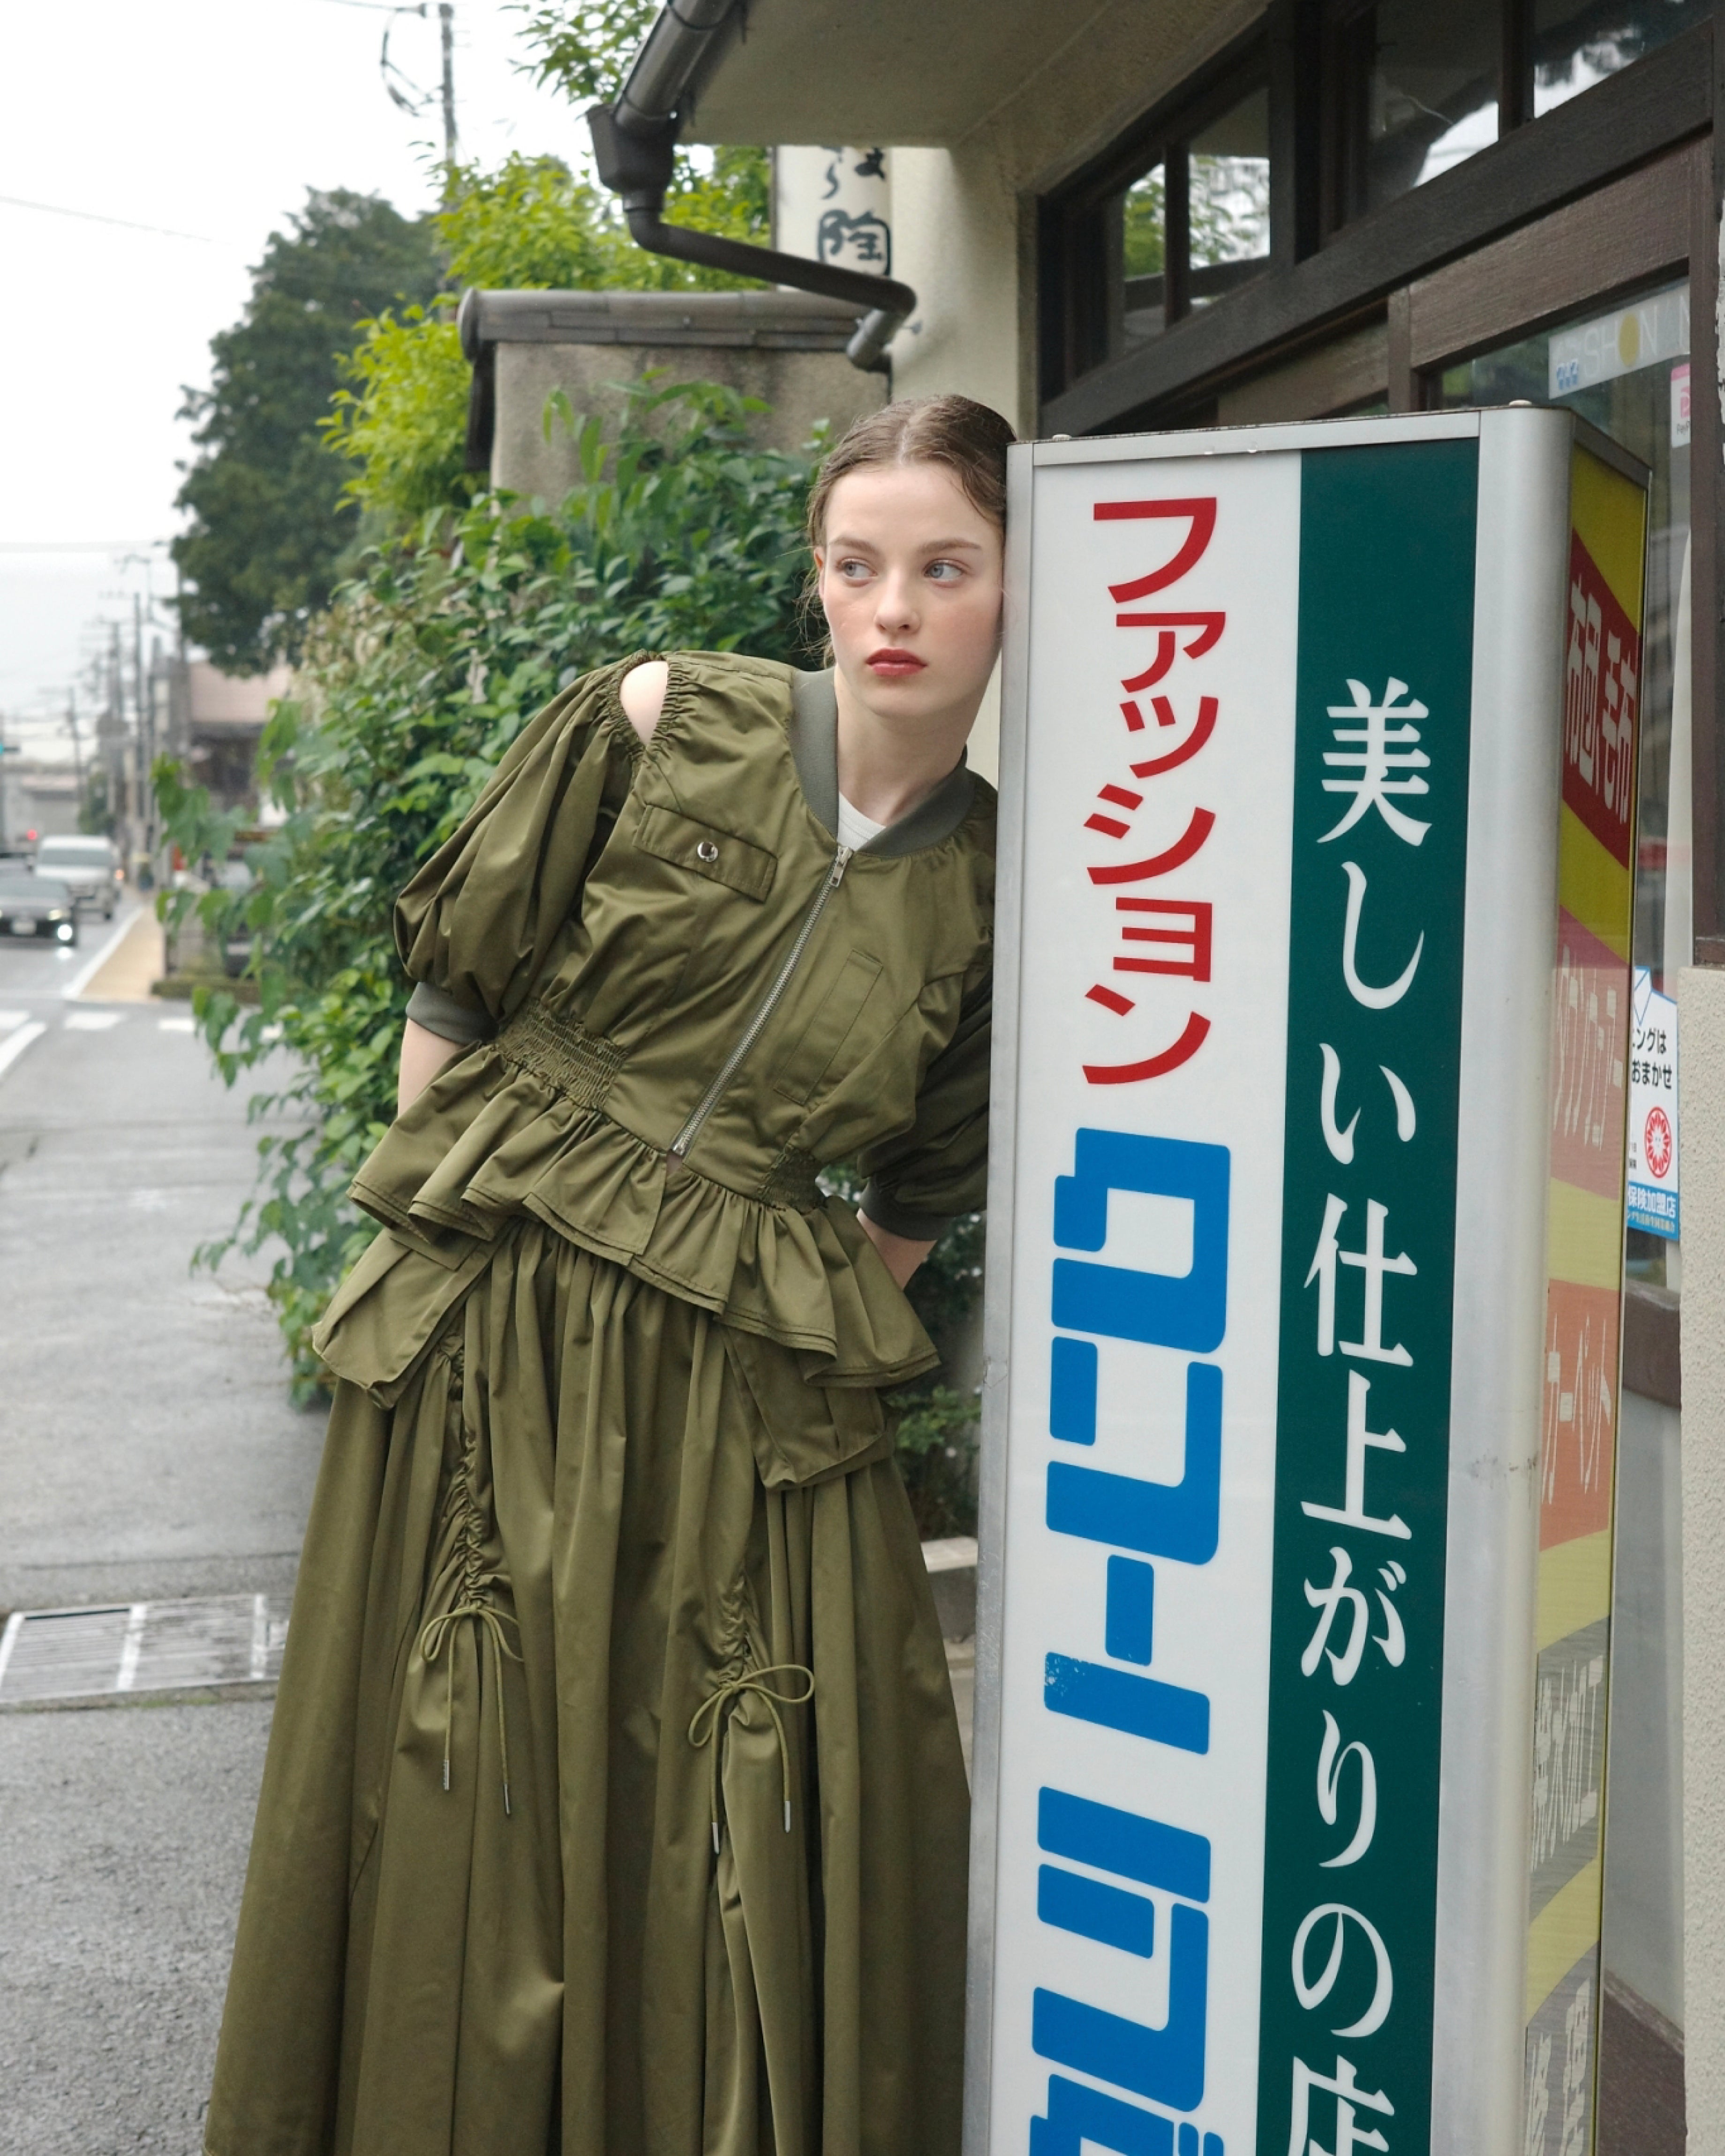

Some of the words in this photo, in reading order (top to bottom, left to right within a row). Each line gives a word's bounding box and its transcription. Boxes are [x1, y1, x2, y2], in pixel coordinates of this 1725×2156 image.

[1083, 497, 1226, 1084] ファッション
[1633, 1028, 1666, 1054] ングは
[1632, 1059, 1672, 1089] おまかせ
